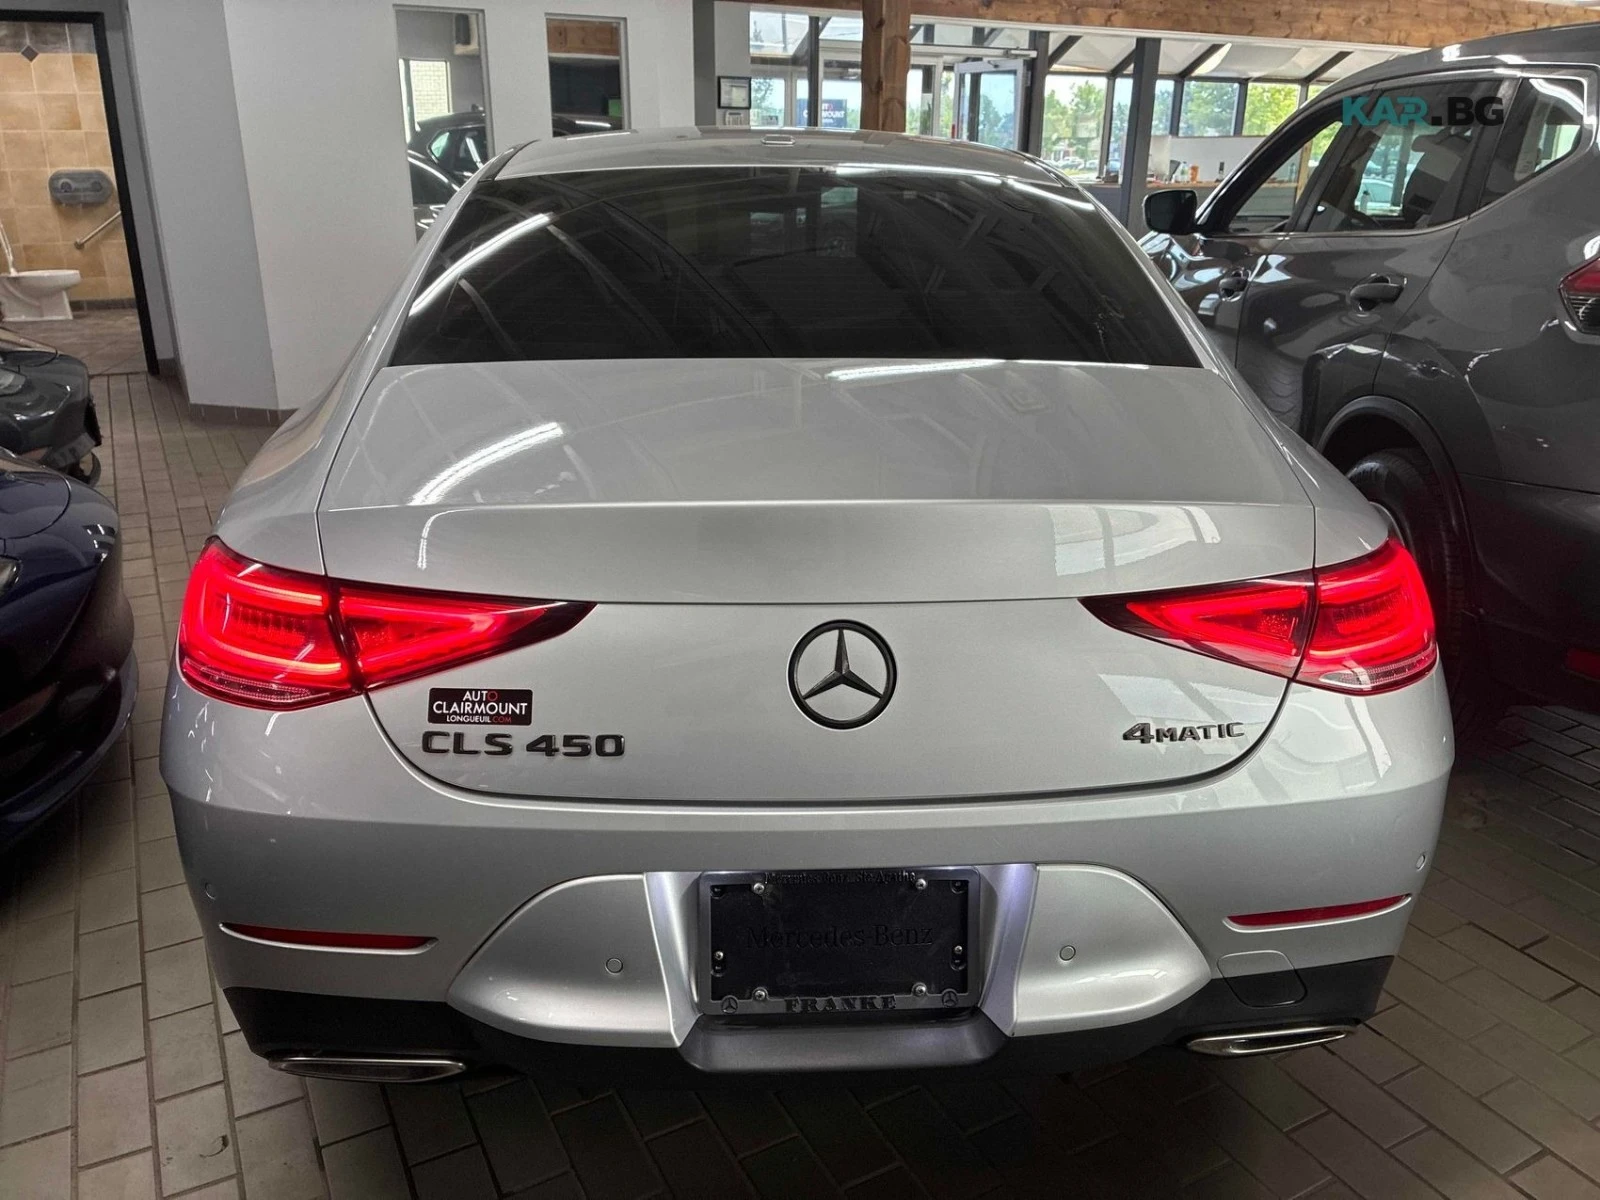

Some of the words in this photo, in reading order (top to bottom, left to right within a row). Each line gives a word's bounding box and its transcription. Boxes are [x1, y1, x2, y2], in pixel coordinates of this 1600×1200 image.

[463, 690, 498, 701] AUTO
[433, 701, 527, 715] CLAIRMOUNT
[446, 714, 512, 724] LONGUEUIL.COM
[1123, 722, 1245, 744] 4MATIC
[422, 731, 513, 755] CLS
[526, 734, 625, 757] 450
[747, 924, 934, 949] Mercedes-Benz
[784, 996, 897, 1013] FRANKE
